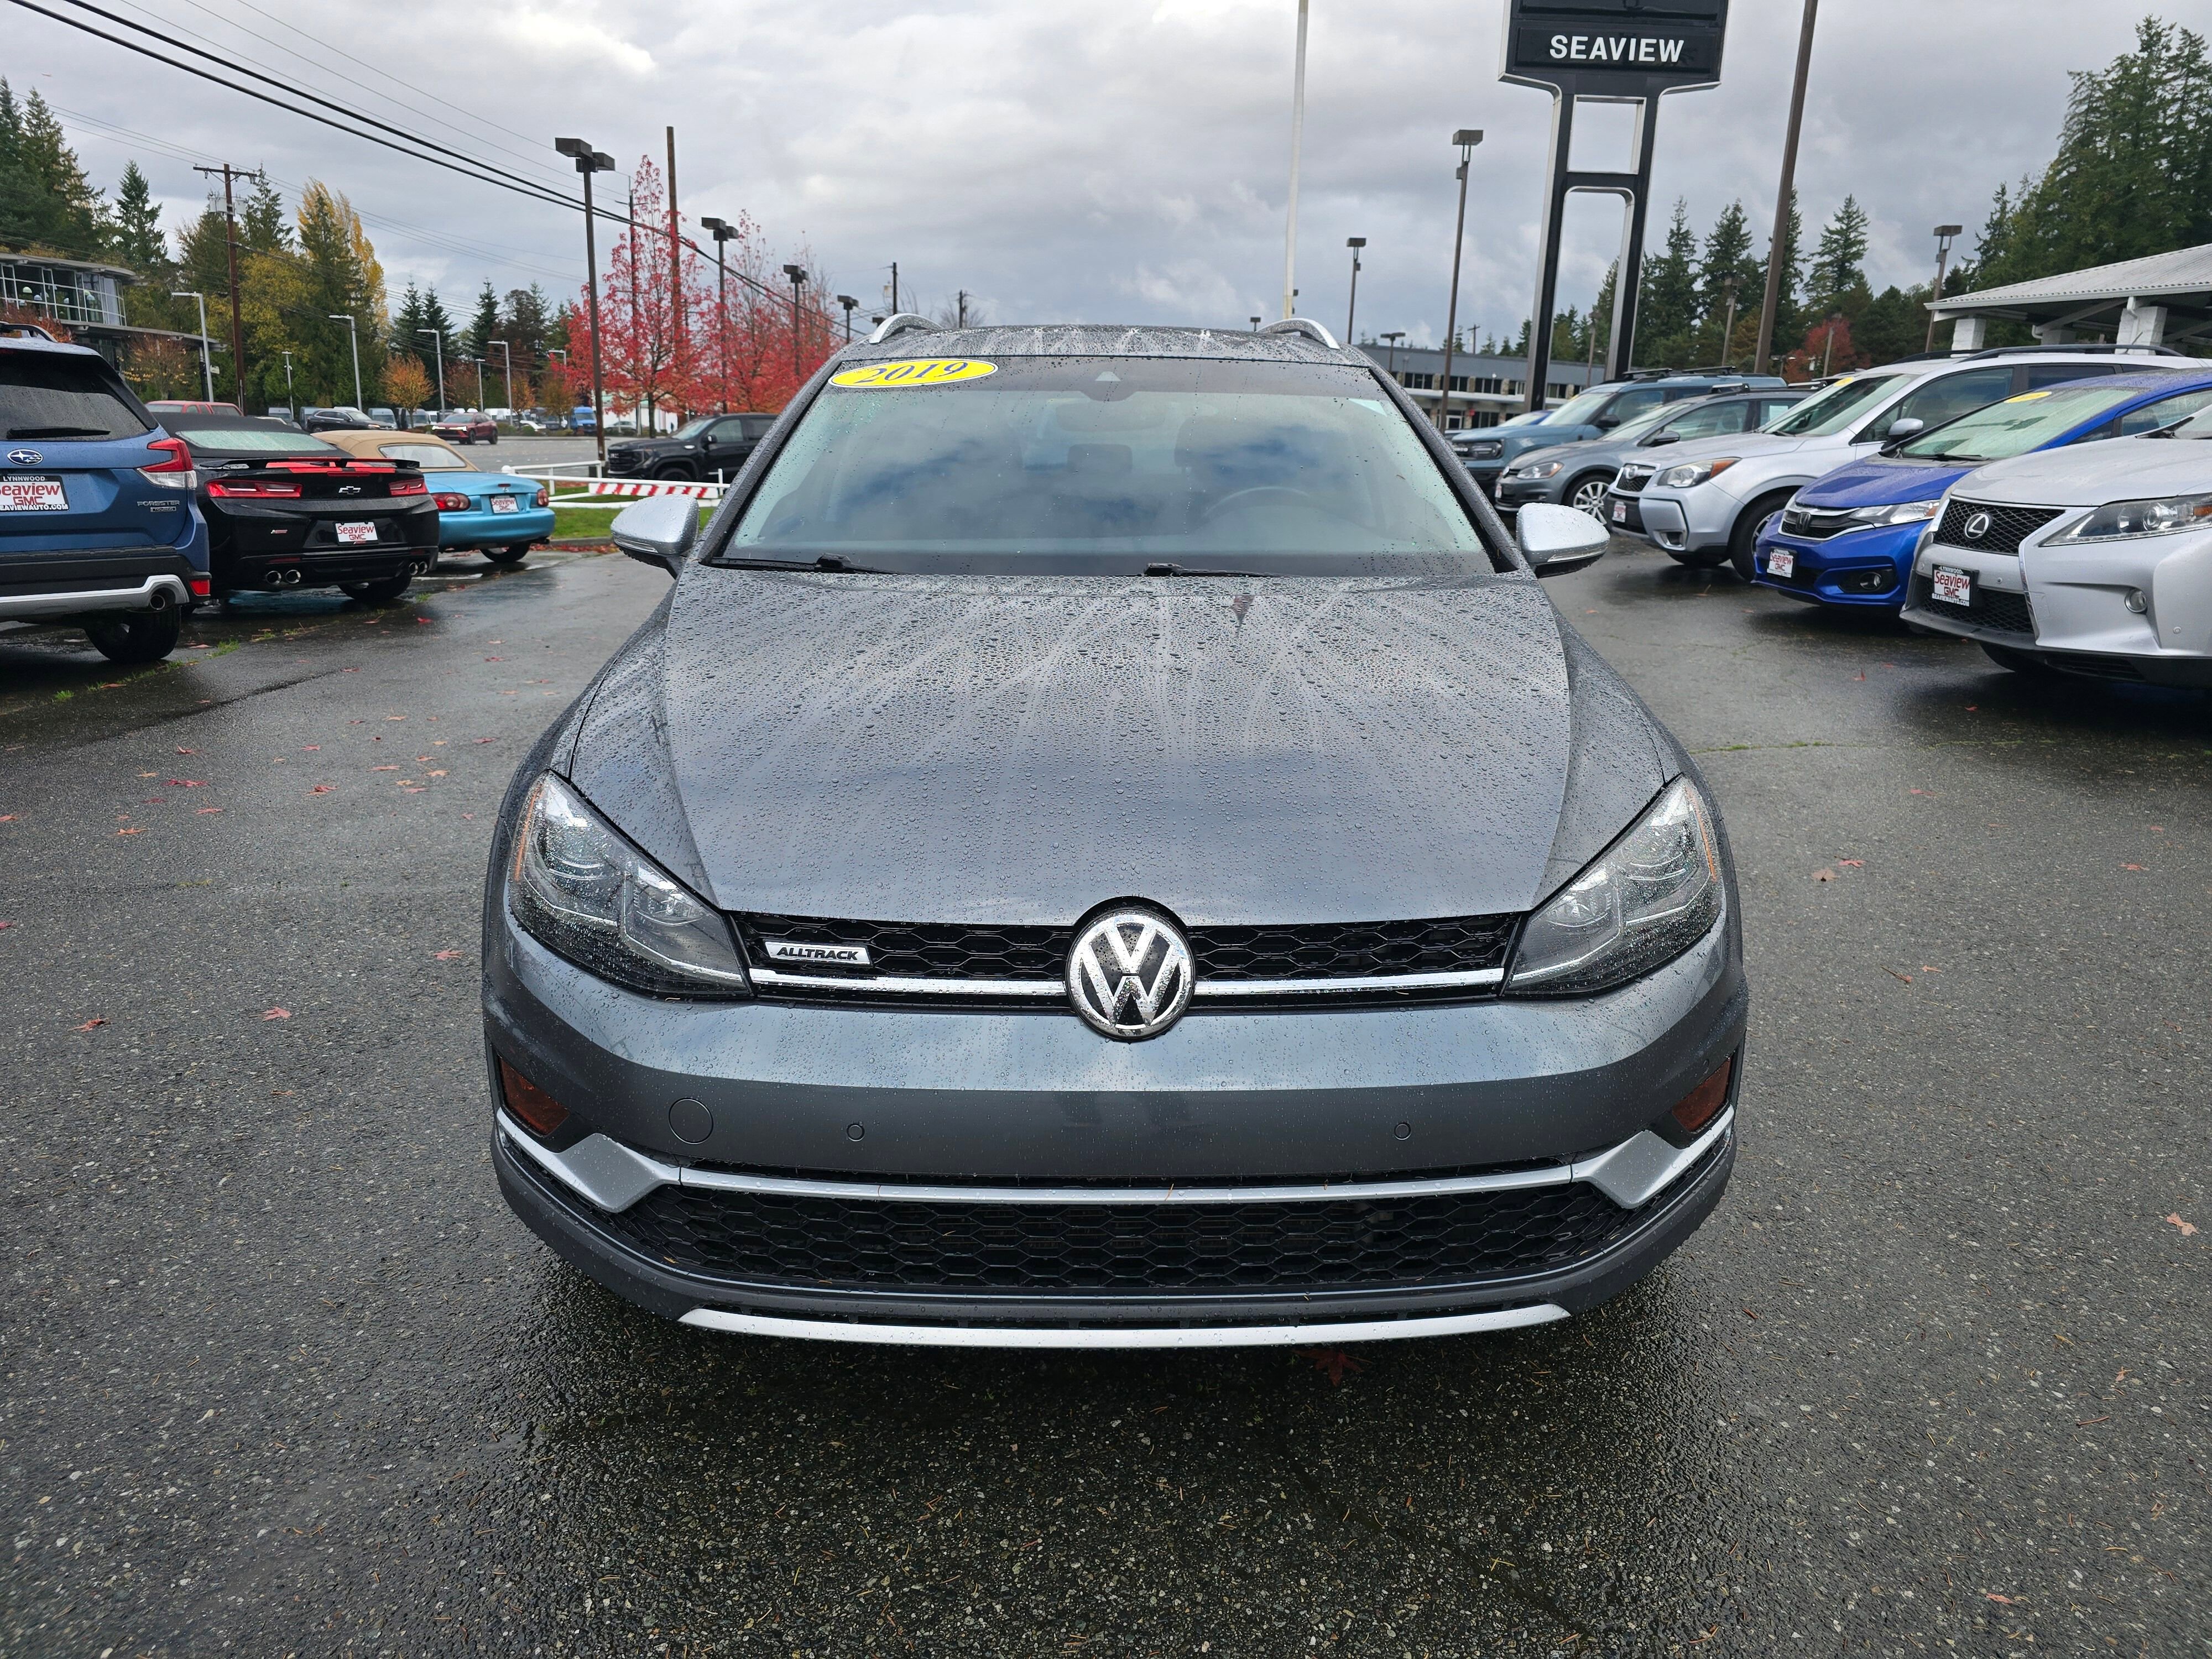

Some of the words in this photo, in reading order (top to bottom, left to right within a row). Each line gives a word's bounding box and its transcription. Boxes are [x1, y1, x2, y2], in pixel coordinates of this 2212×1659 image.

[1550, 35, 1684, 62] SEAVIEW
[854, 362, 968, 383] 2019
[0, 483, 60, 495] eaview
[13, 497, 45, 505] GMC
[337, 524, 374, 534] Seaview
[1935, 571, 1970, 590] Seaview
[1944, 586, 1960, 598] GMC
[777, 947, 859, 961] ALLTRACK
